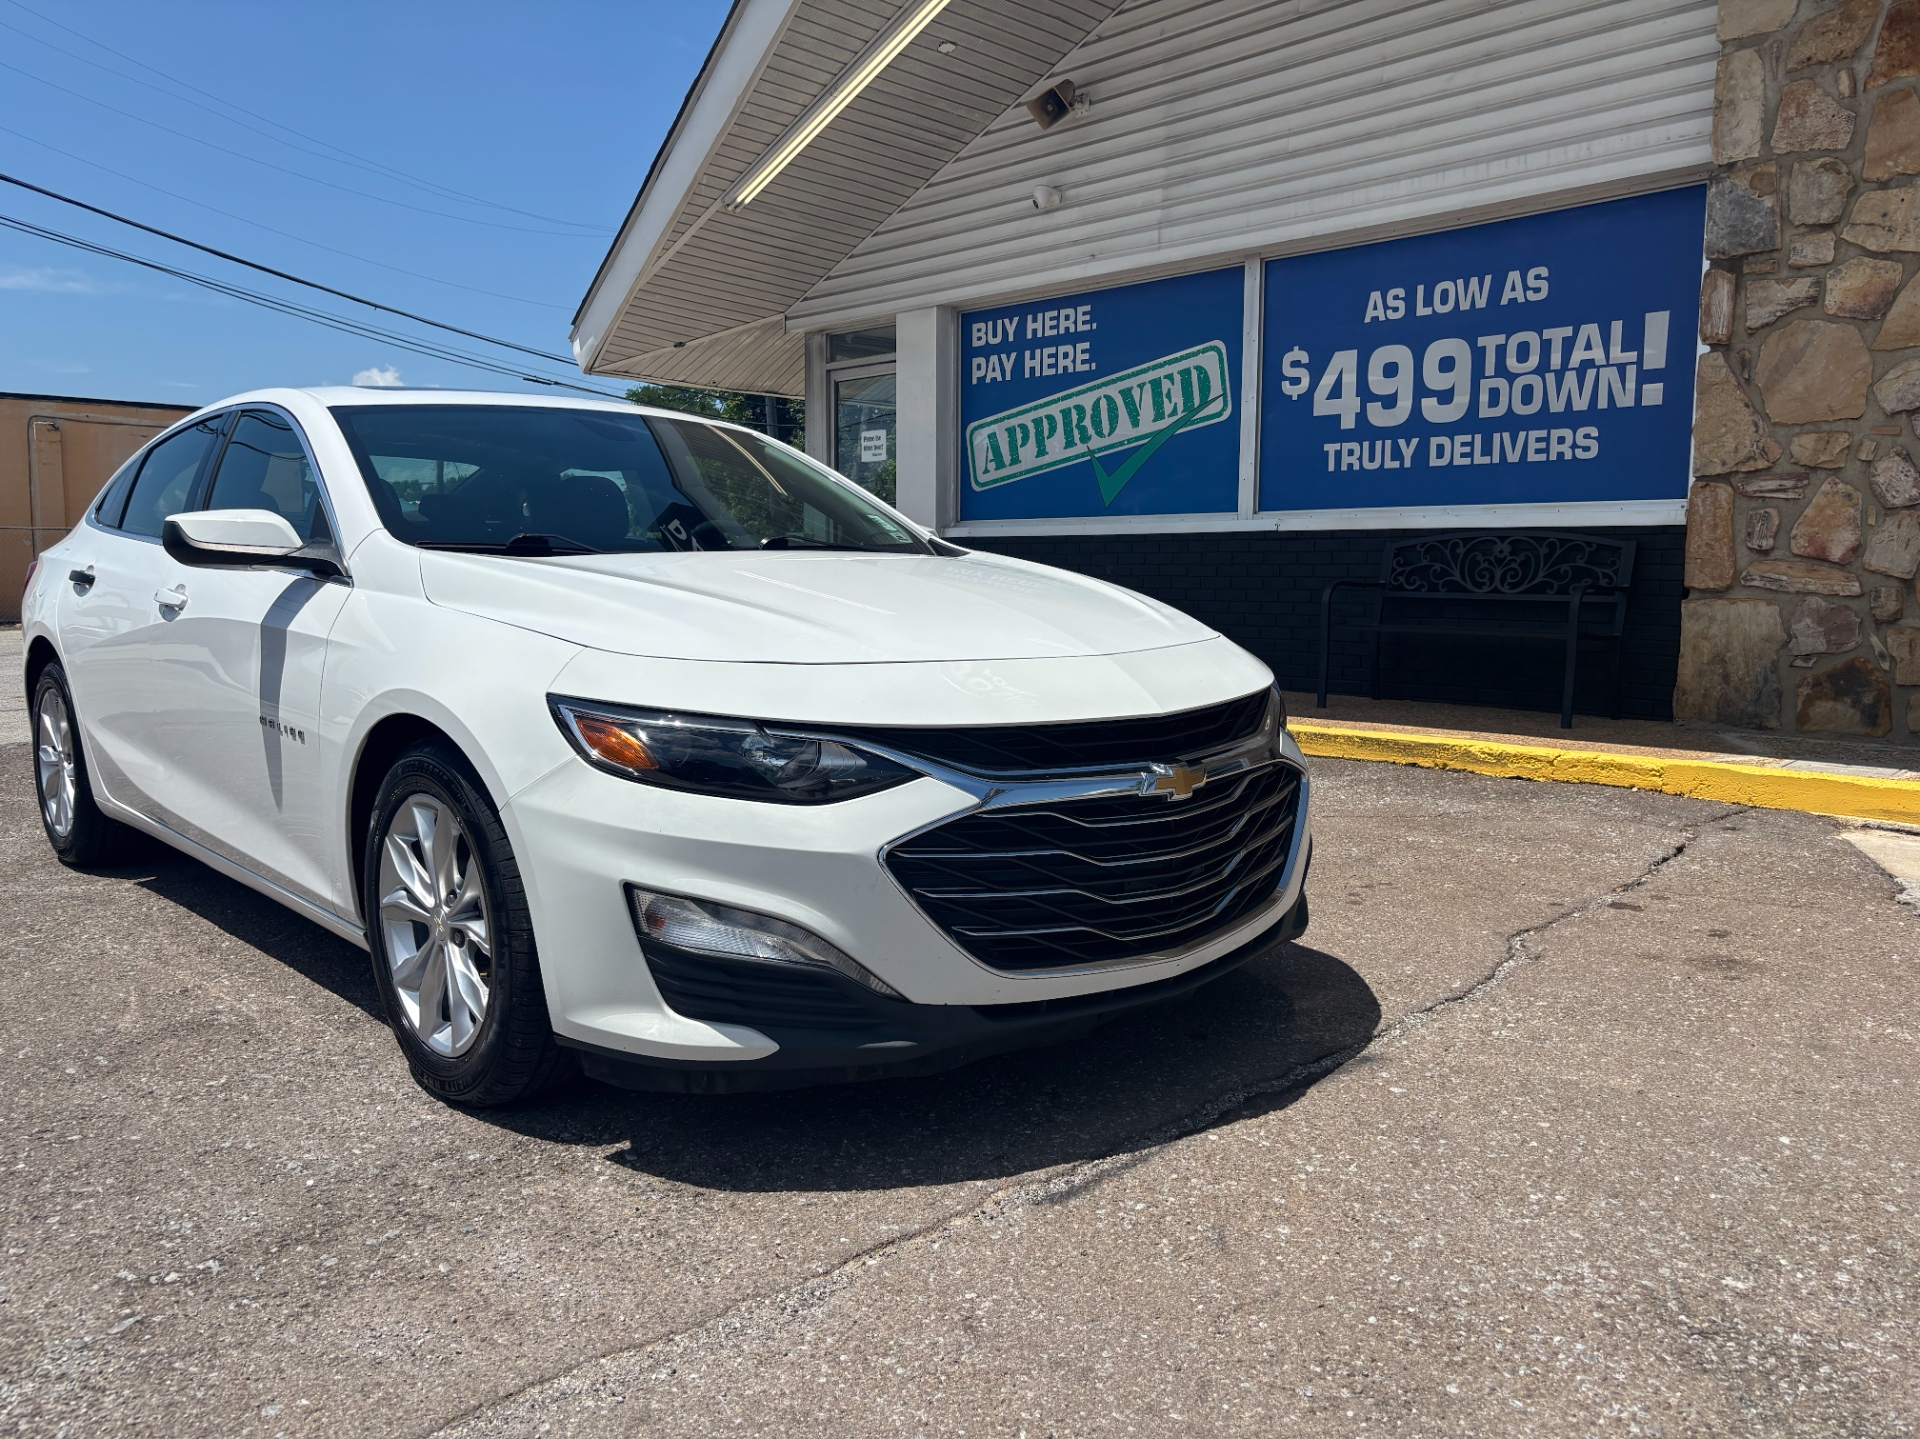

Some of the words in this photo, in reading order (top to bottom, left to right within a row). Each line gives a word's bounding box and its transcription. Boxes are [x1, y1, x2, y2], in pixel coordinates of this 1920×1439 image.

[1364, 288, 1406, 323] AS
[1416, 275, 1492, 316] LOW
[1500, 267, 1549, 305] AS
[972, 316, 1020, 347] BUY
[1026, 304, 1097, 339] HERE.
[972, 352, 1017, 384] PAY
[1025, 341, 1096, 378] HERE.
[1282, 337, 1472, 430] $499
[1478, 319, 1638, 376] TOTAL
[981, 364, 1212, 475] APPROVED
[1323, 437, 1420, 472] TRULY
[1429, 426, 1599, 467] DELIVERS
